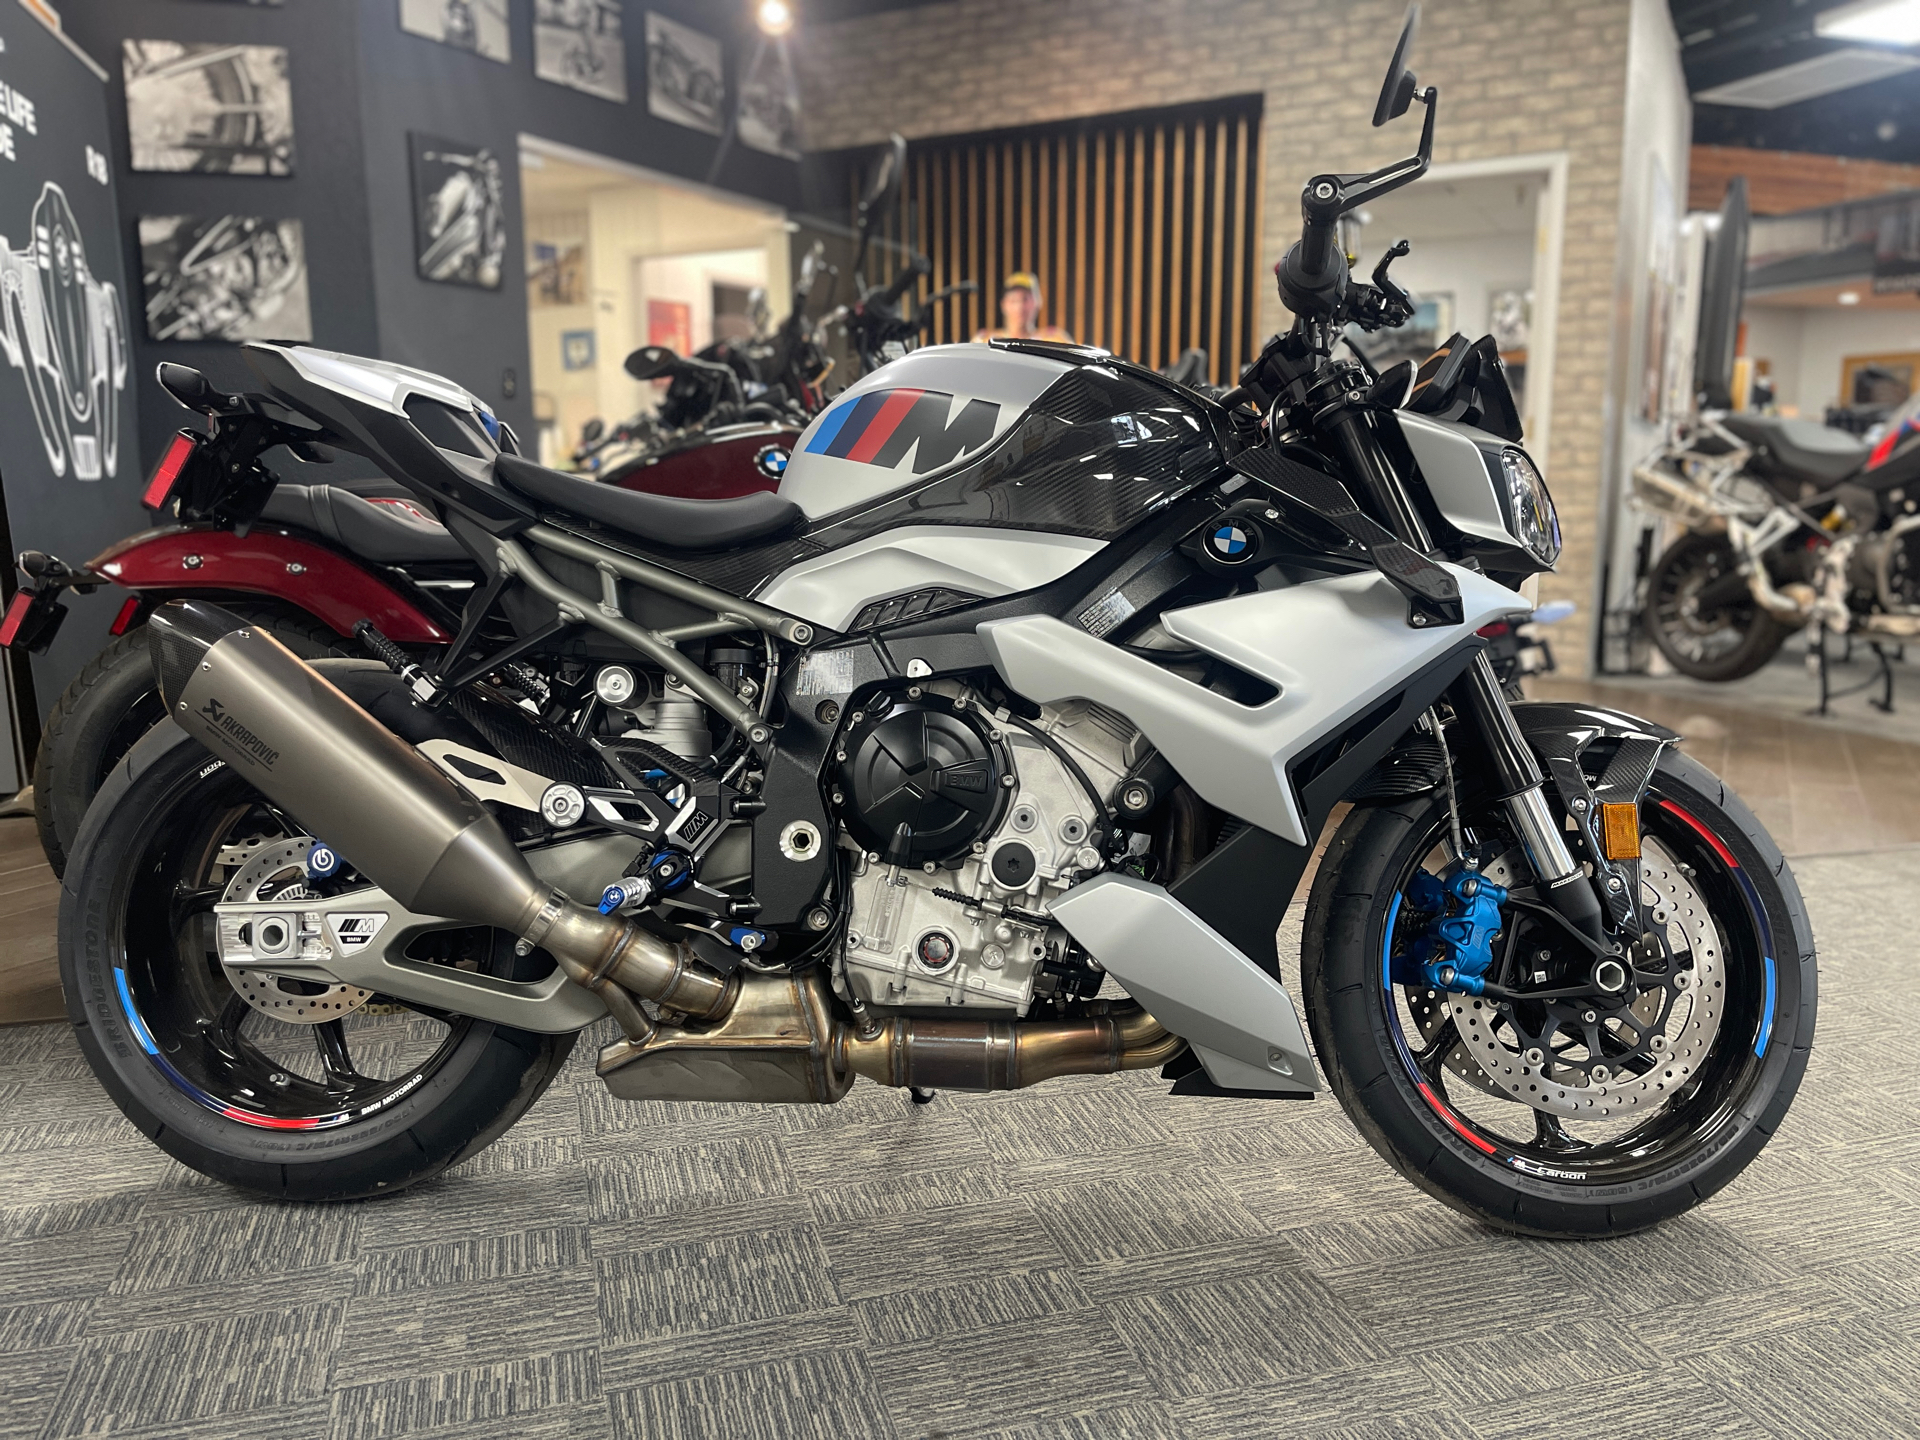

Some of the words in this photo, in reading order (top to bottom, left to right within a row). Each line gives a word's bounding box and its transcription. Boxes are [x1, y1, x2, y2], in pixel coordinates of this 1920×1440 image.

[1210, 519, 1255, 537] BMW
[950, 774, 983, 787] BMW
[85, 898, 134, 1059] BRIDGESTONE
[361, 1100, 382, 1116] BMW
[382, 1073, 423, 1106] MOTORRAD
[1536, 1166, 1587, 1180] Carbon
